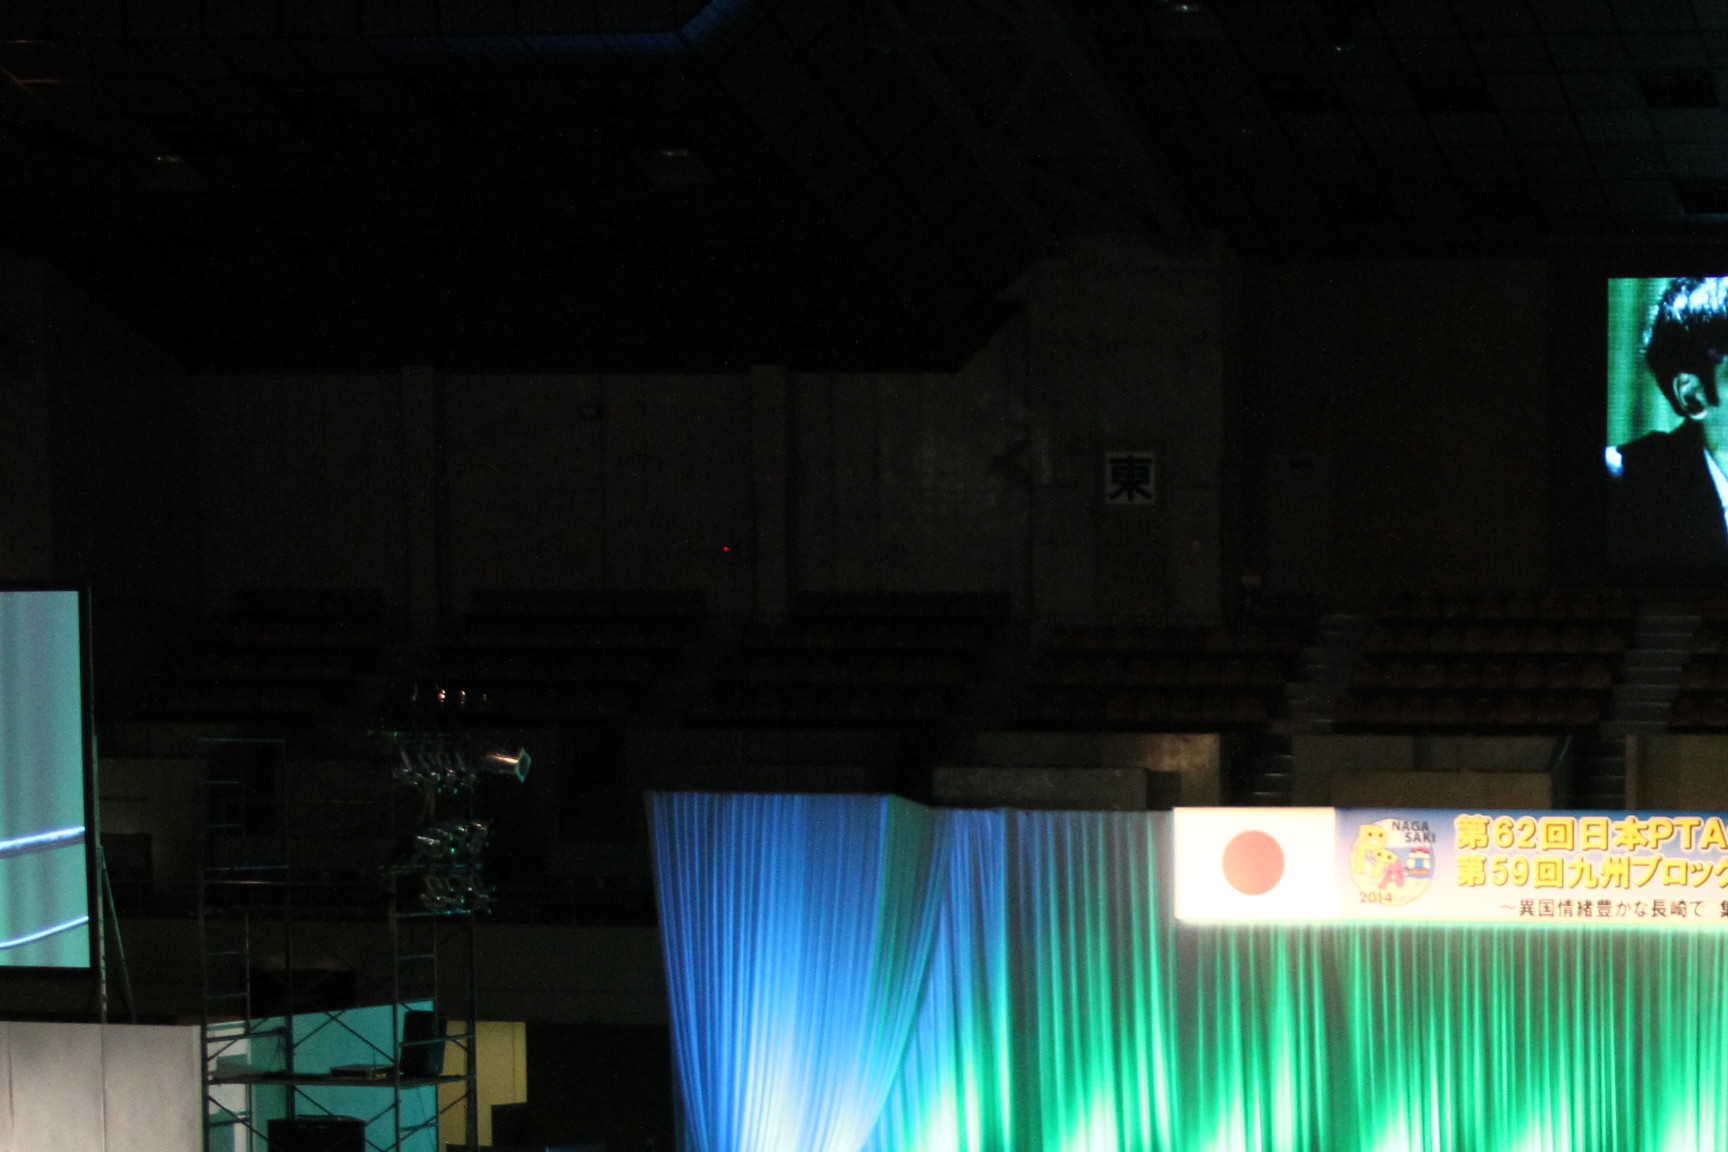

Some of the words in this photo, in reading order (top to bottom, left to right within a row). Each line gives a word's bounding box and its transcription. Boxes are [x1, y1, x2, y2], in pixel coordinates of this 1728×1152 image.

[1108, 454, 1153, 502] 東
[1391, 820, 1430, 832] NAGA
[1405, 831, 1437, 844] SAKI
[1360, 891, 1393, 903] 2014
